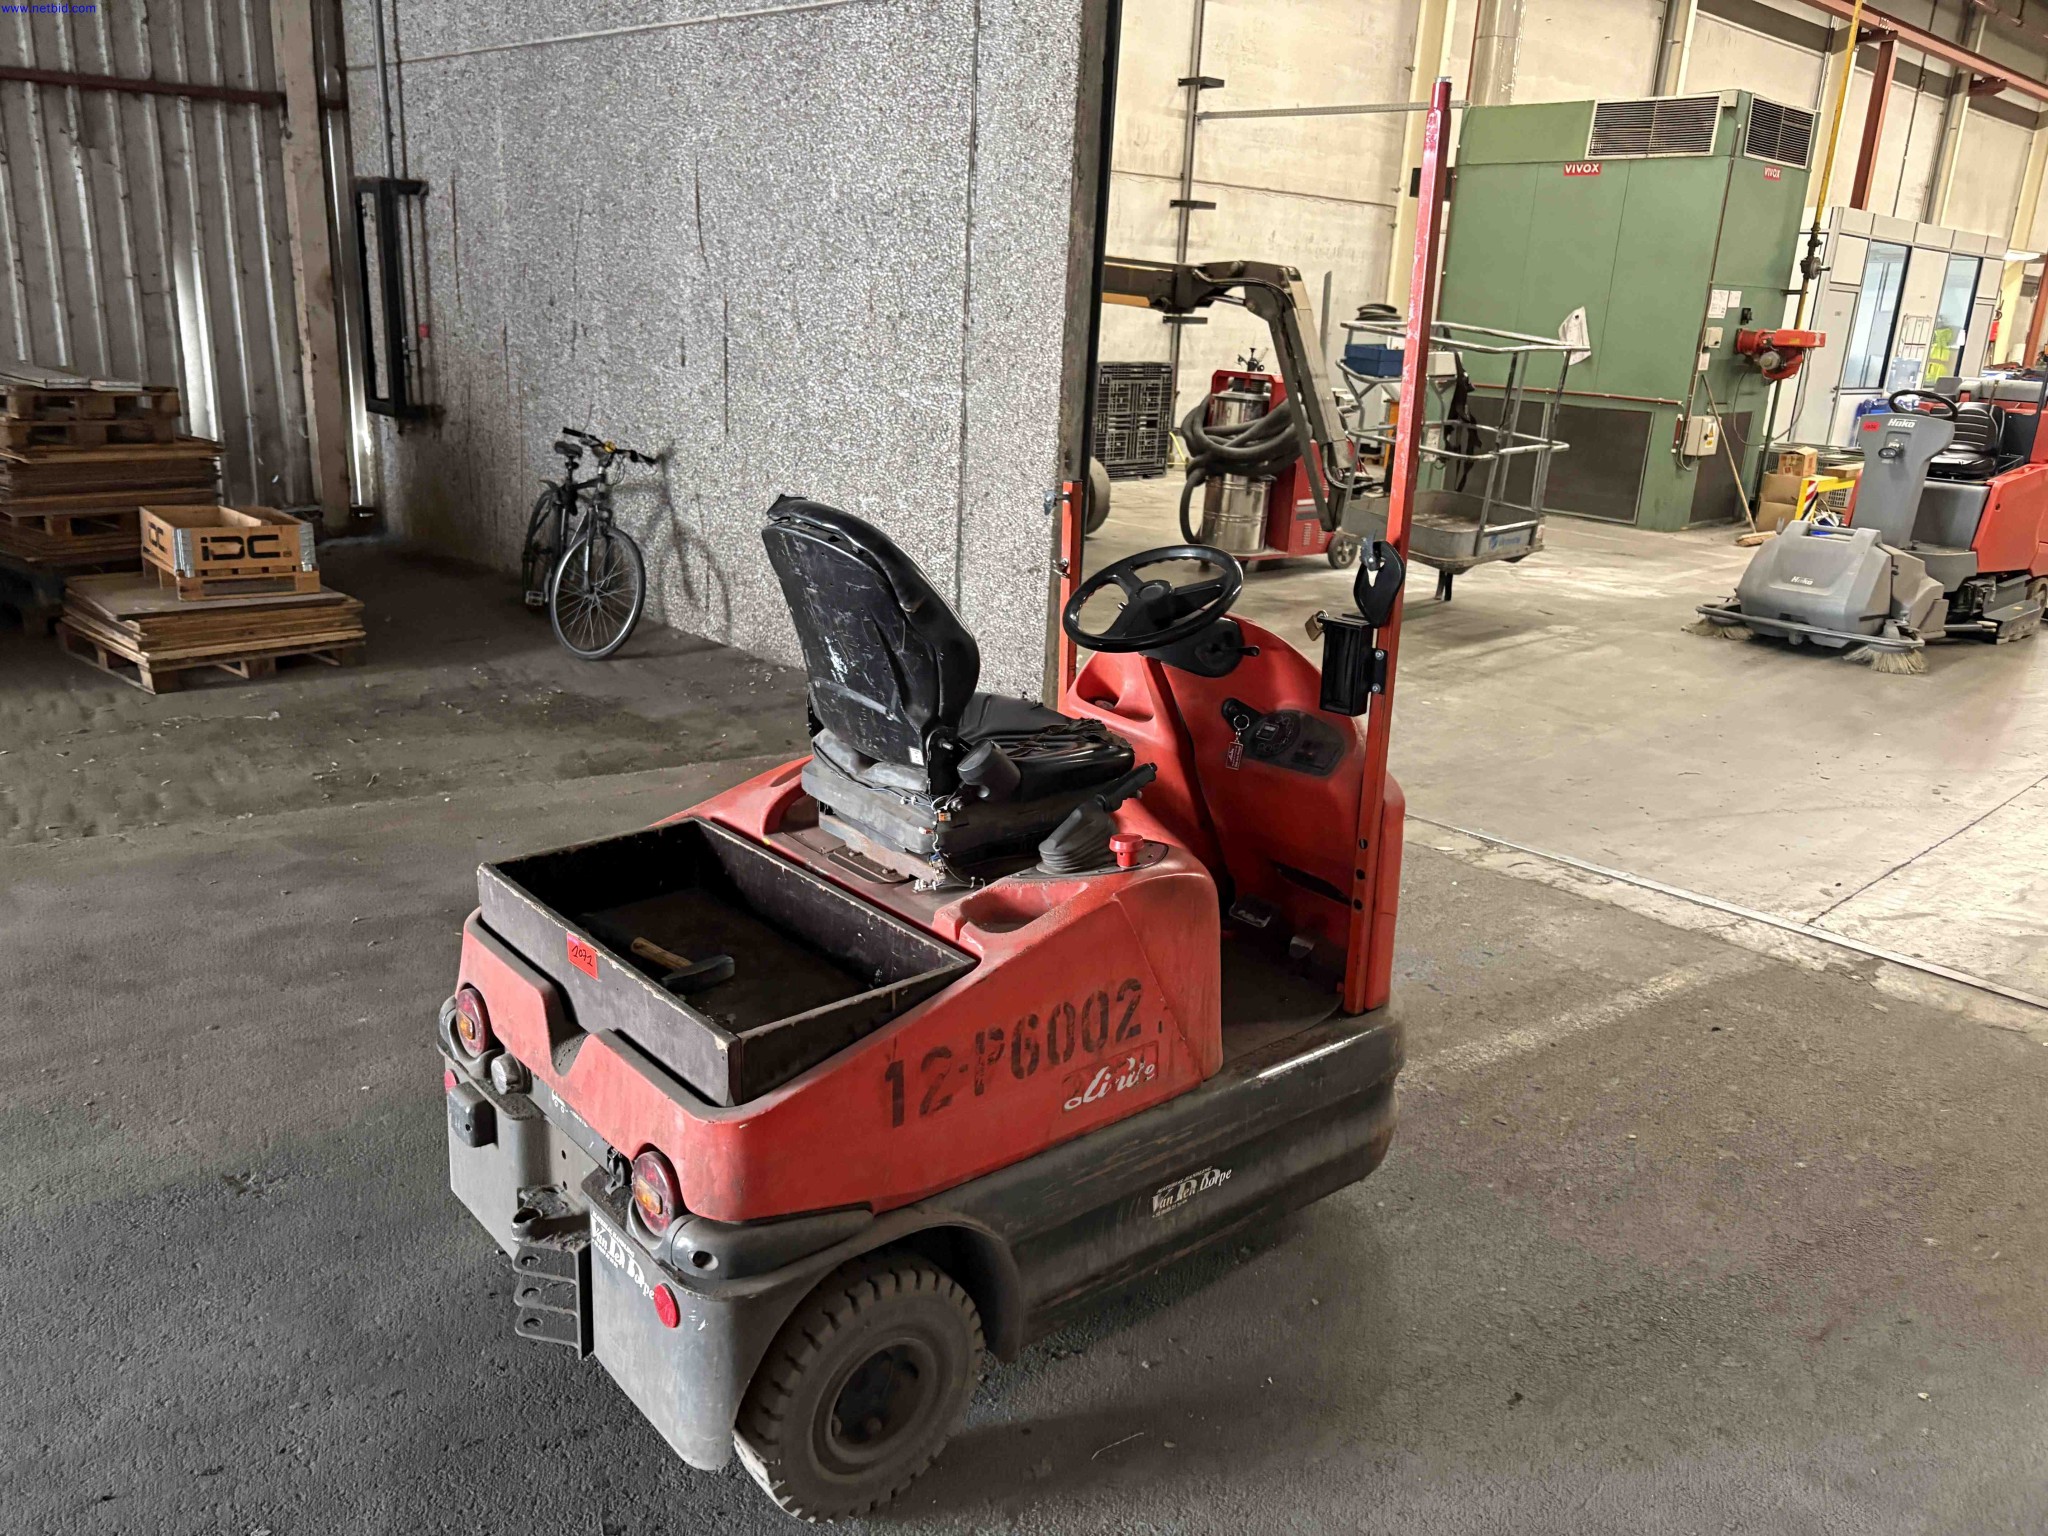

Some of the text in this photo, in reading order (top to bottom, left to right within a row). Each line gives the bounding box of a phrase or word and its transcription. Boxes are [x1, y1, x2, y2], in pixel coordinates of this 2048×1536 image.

[1565, 163, 1599, 174] VIVOX
[1764, 167, 1781, 179] VIVOX
[1887, 418, 1917, 428] Hako
